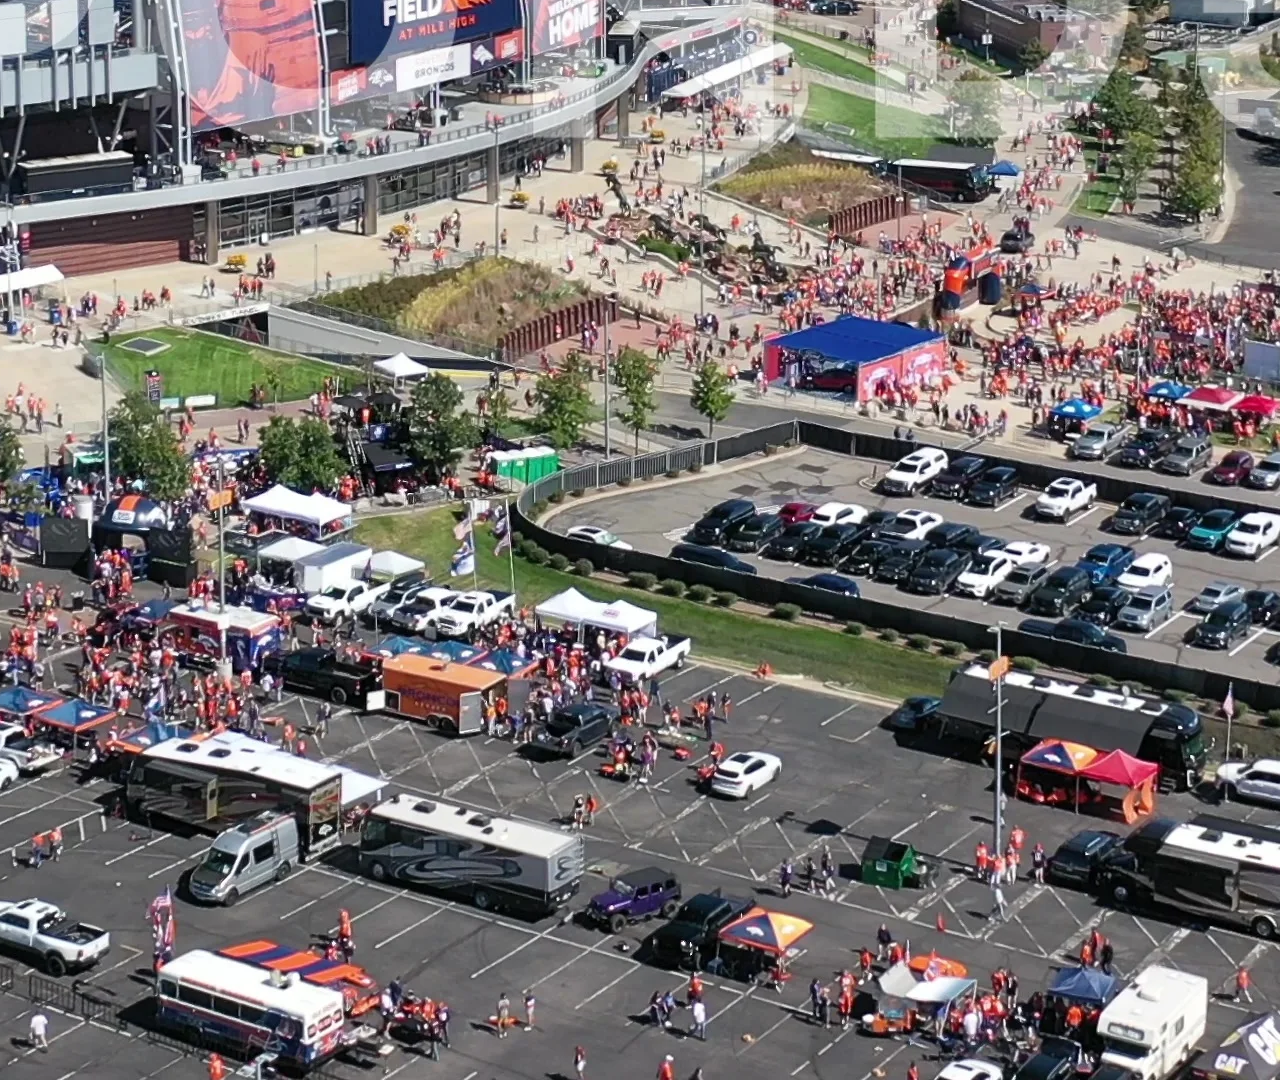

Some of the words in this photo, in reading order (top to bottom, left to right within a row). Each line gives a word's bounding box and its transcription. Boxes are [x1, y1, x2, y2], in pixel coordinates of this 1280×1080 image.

[398, 27, 413, 41] AT
[419, 21, 446, 38] MILE
[448, 14, 476, 30] HIGH
[414, 60, 455, 80] BRONCOS
[1214, 1053, 1249, 1075] CAT
